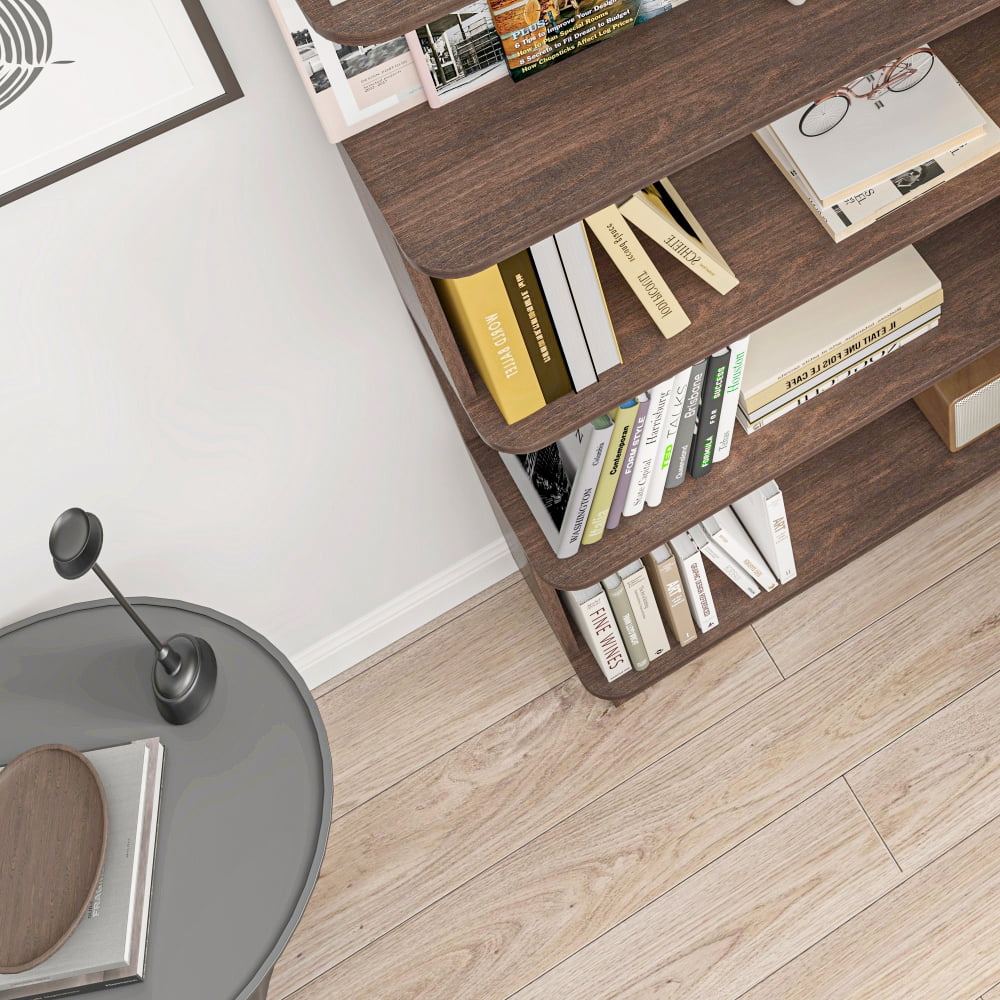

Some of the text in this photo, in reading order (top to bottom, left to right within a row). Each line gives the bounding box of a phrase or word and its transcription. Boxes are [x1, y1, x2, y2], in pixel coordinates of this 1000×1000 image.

[511, 19, 549, 41] PLUS:
[517, 46, 535, 57] How
[543, 35, 559, 45] Plan
[559, 23, 584, 37] Special
[586, 11, 609, 25] Rooms
[521, 35, 537, 46] Tips
[547, 17, 576, 34] Improve
[576, 9, 592, 20] Your
[521, 17, 634, 74] How Chopsticks Affect Log Prices
[526, 47, 553, 62] Secrets
[554, 41, 562, 49] to
[562, 36, 573, 45] Fit
[574, 26, 597, 40] Dream
[605, 9, 631, 25] Budget
[684, 372, 703, 419] Brisbane
[727, 351, 745, 394] Houston
[645, 390, 670, 446] Harrisburg
[661, 384, 688, 471] TED TALKS
[700, 365, 726, 468] FORMULA FOR SUCCESS
[624, 415, 647, 475] FORM STYLE
[675, 444, 689, 480] Queensland
[569, 487, 593, 544] WASHINGTON
[589, 606, 624, 670] FINE WINES
